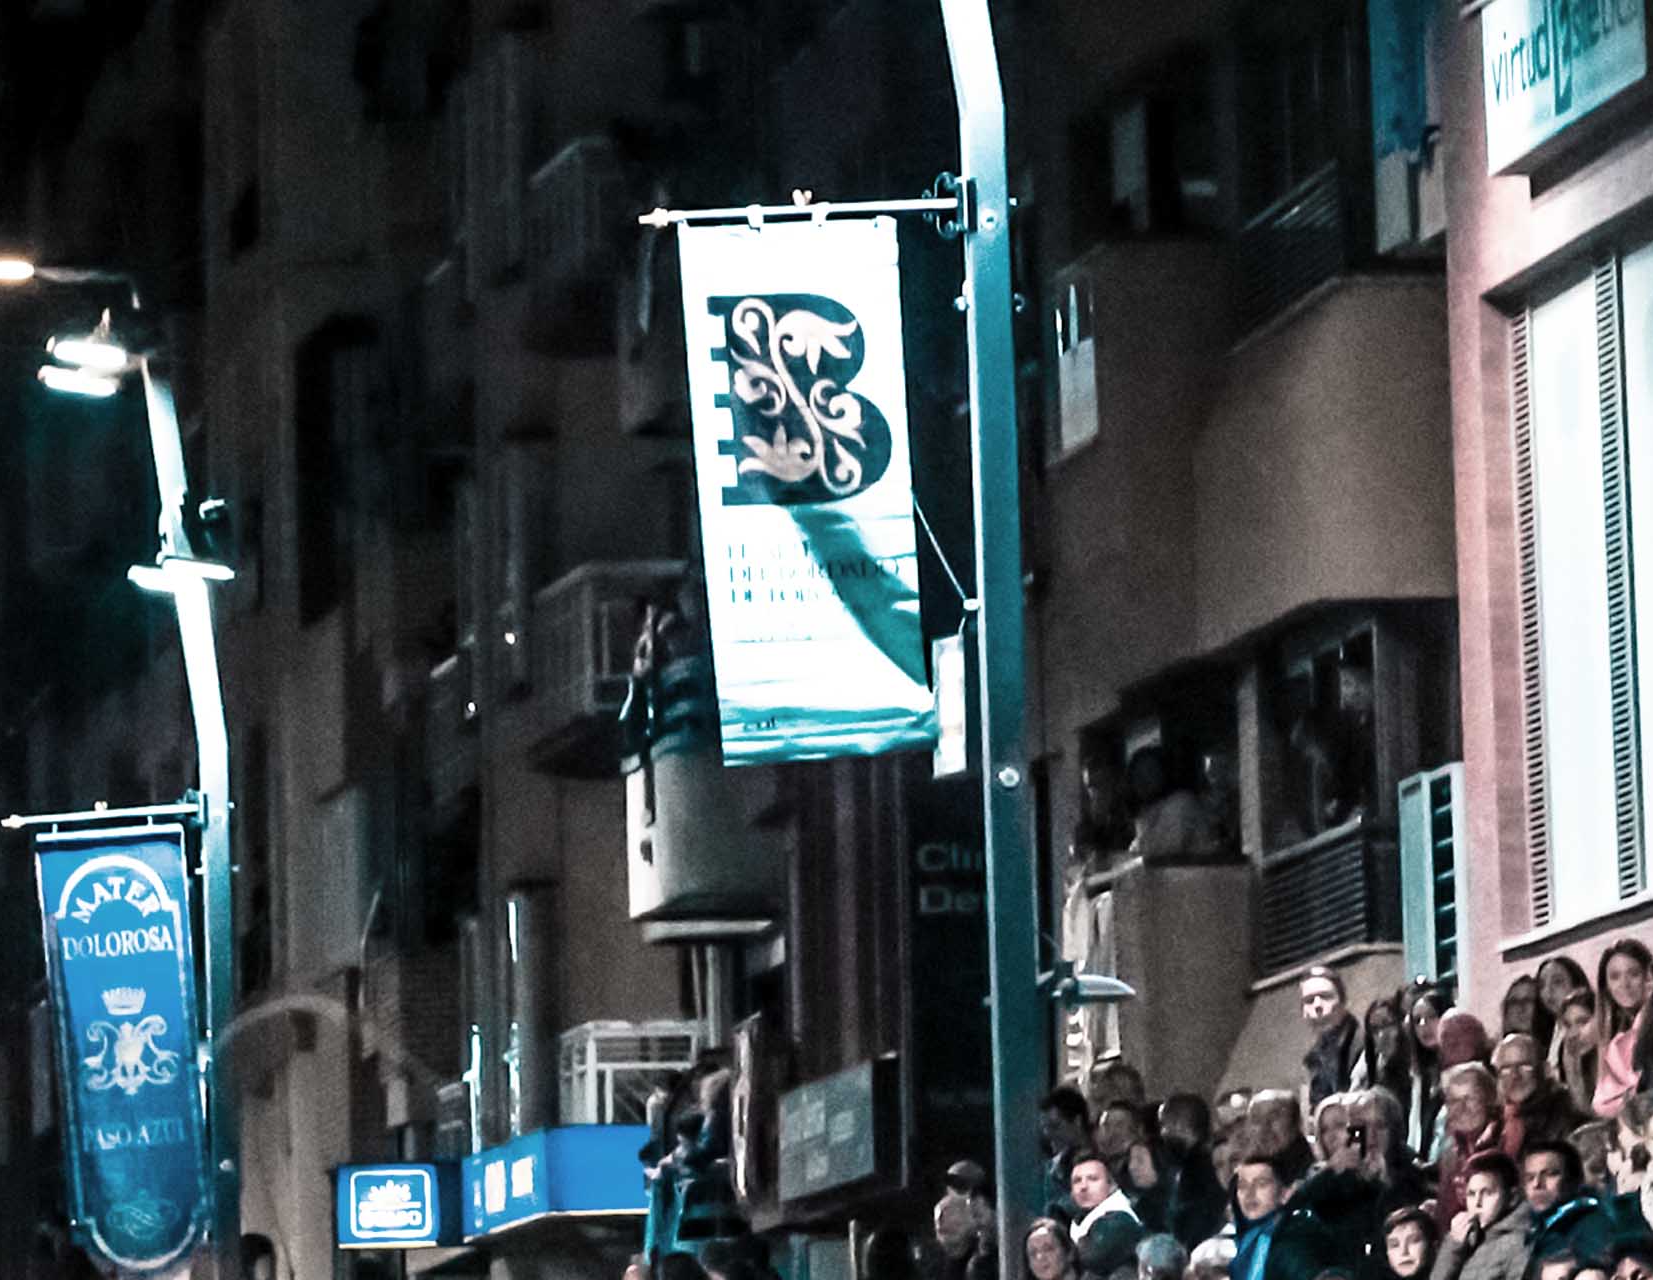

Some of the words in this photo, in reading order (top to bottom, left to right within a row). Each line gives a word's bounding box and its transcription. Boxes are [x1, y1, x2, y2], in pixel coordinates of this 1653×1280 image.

[1491, 0, 1551, 104] virtud
[71, 876, 162, 925] MATER
[62, 925, 175, 961] DOLOROSA
